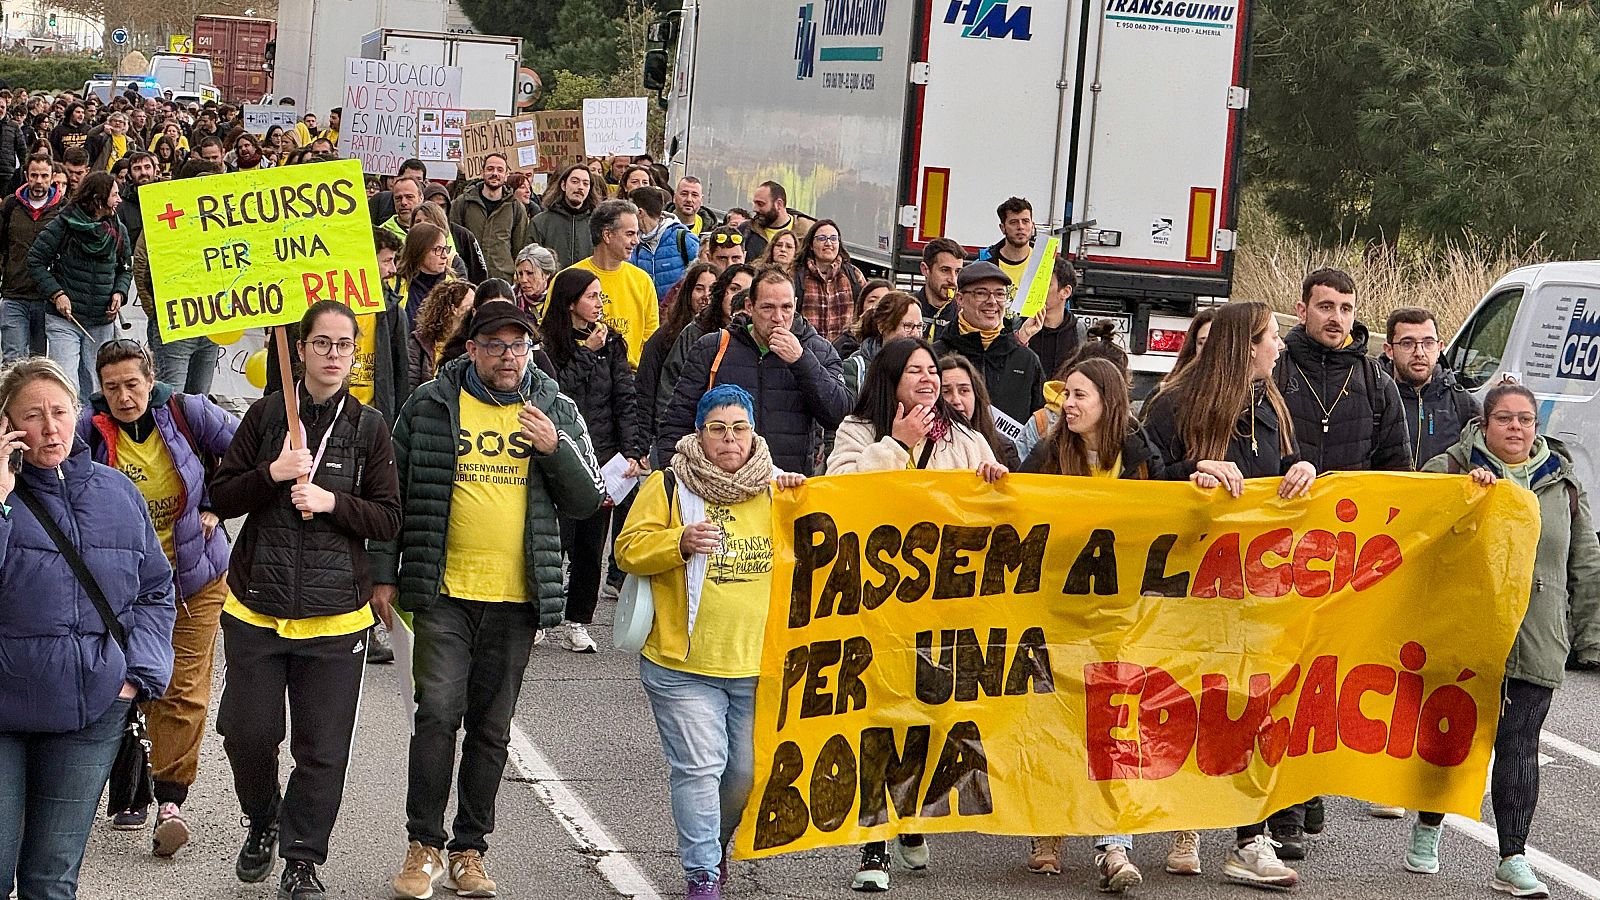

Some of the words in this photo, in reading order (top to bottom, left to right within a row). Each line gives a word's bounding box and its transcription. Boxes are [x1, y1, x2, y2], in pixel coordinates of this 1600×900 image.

[1105, 0, 1235, 21] TRANSAGUIMU
[351, 60, 446, 87] L'EDUCACIÓ
[346, 85, 369, 110] NO
[374, 84, 399, 113] ÉS
[587, 100, 641, 115] SISTEMA
[351, 110, 369, 134] ÉS
[375, 113, 418, 139] INVER
[586, 117, 635, 129] EDUCATIU
[464, 126, 489, 155] FINS
[197, 178, 357, 232] RECURSOS
[203, 241, 252, 273] PER
[273, 233, 331, 262] UNA
[166, 277, 288, 331] EDUCACIÓ
[302, 267, 380, 309] REAL
[1561, 334, 1600, 377] CEO
[458, 429, 532, 459] SOS
[458, 463, 519, 475] ENSENYAMENT
[479, 474, 491, 483] DE
[788, 511, 1051, 629] PASSEM
[1062, 528, 1119, 596] A
[1140, 498, 1403, 600] L'ACCIÓ
[777, 635, 873, 733] PER
[915, 626, 1056, 706] UNA
[1084, 641, 1478, 782] EDUCACIÓ
[753, 719, 994, 852] BONA
